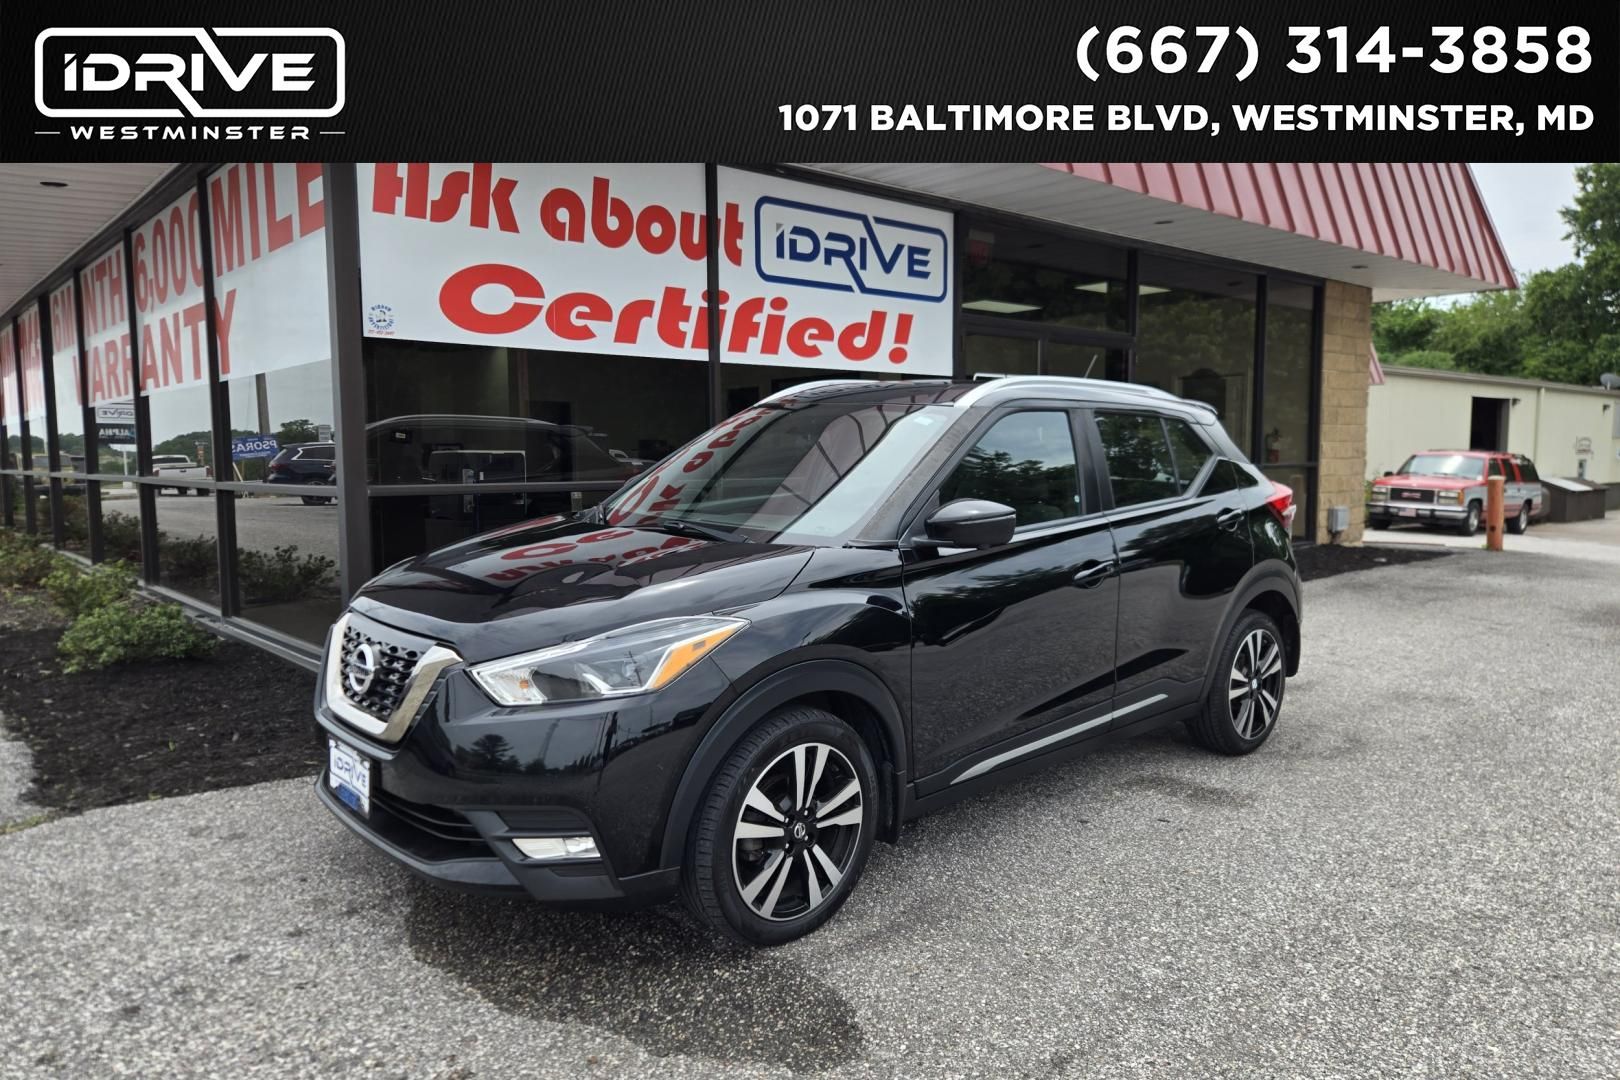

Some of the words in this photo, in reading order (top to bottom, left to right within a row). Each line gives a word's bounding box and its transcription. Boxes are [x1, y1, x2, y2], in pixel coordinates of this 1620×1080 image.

[372, 162, 519, 233] Ask
[540, 176, 744, 267] about
[438, 263, 914, 365] Certified!
